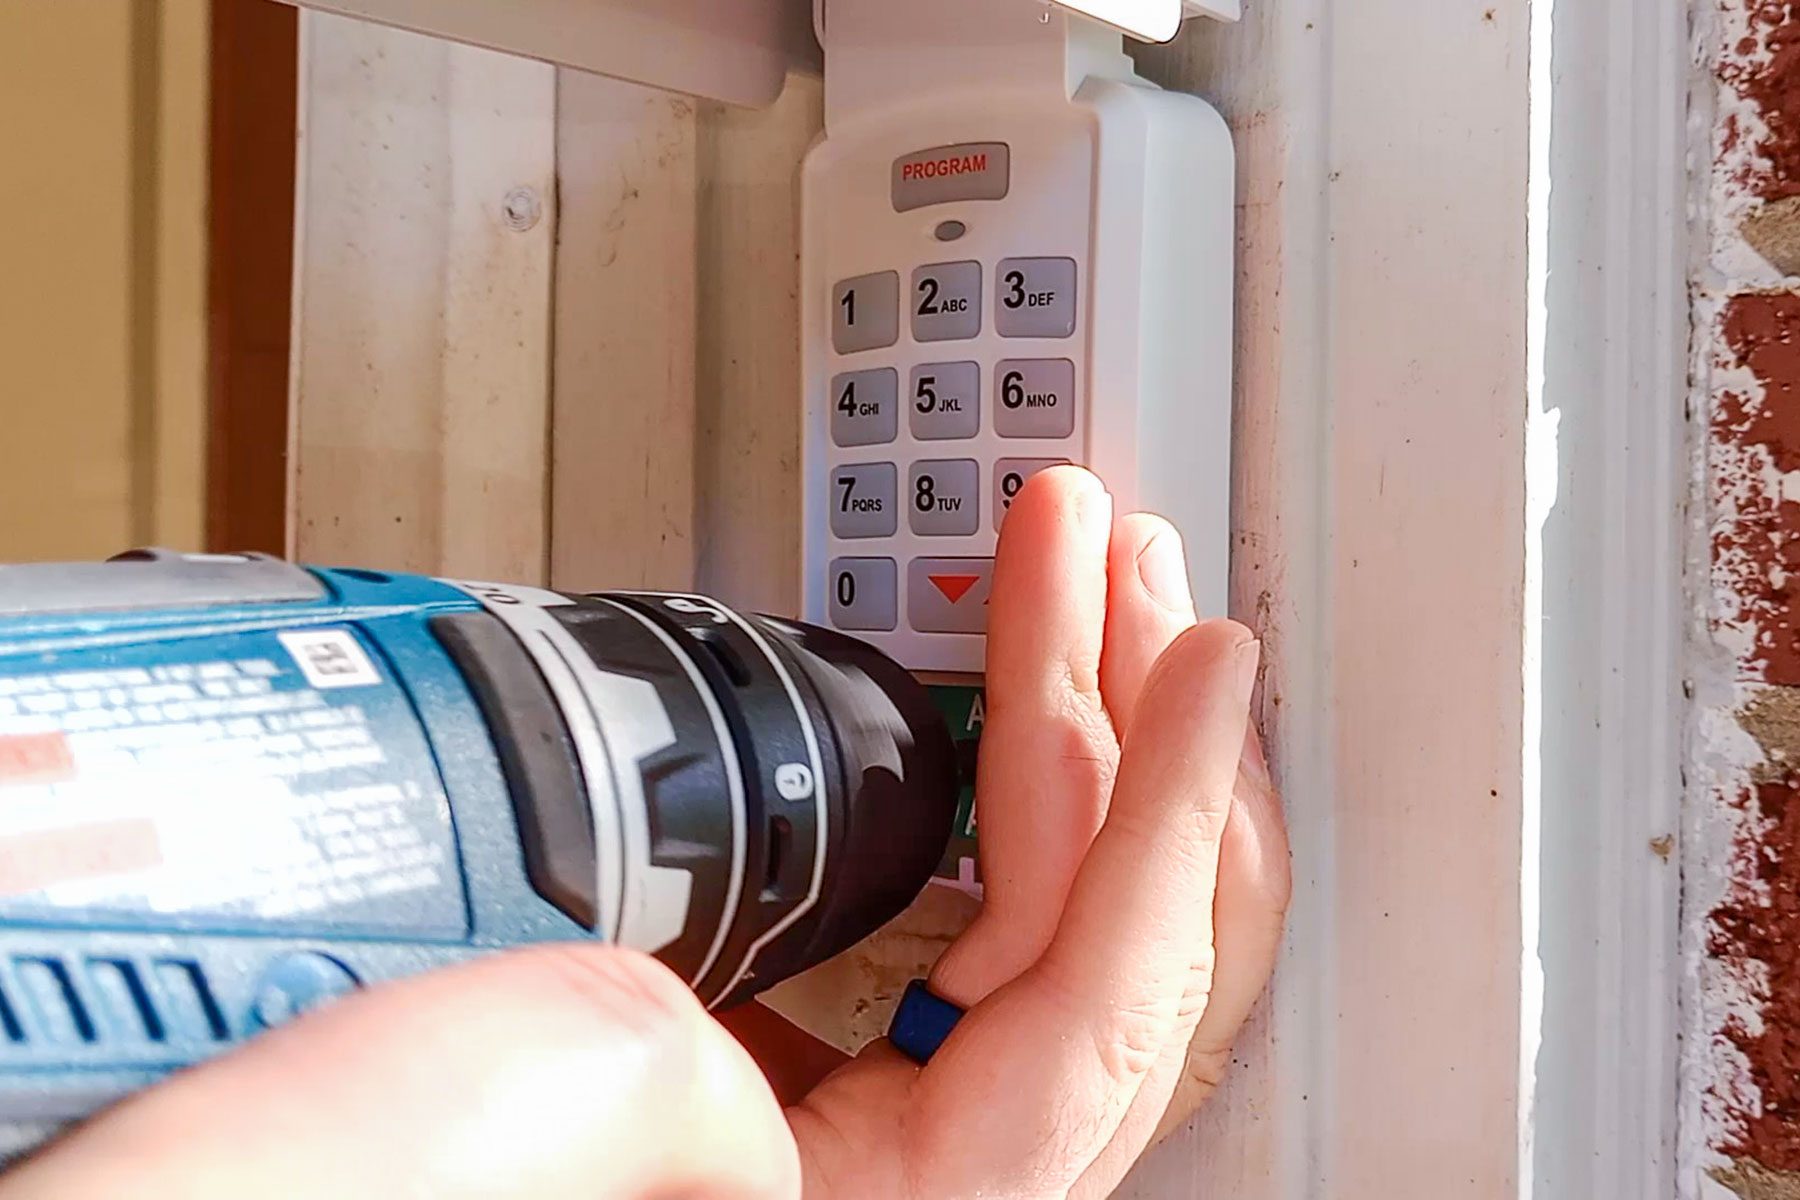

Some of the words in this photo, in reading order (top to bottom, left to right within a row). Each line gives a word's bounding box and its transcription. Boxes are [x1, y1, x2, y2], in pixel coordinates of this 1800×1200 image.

[902, 154, 987, 181] PROGRAM
[841, 290, 855, 326] 1
[837, 571, 856, 607] 0
